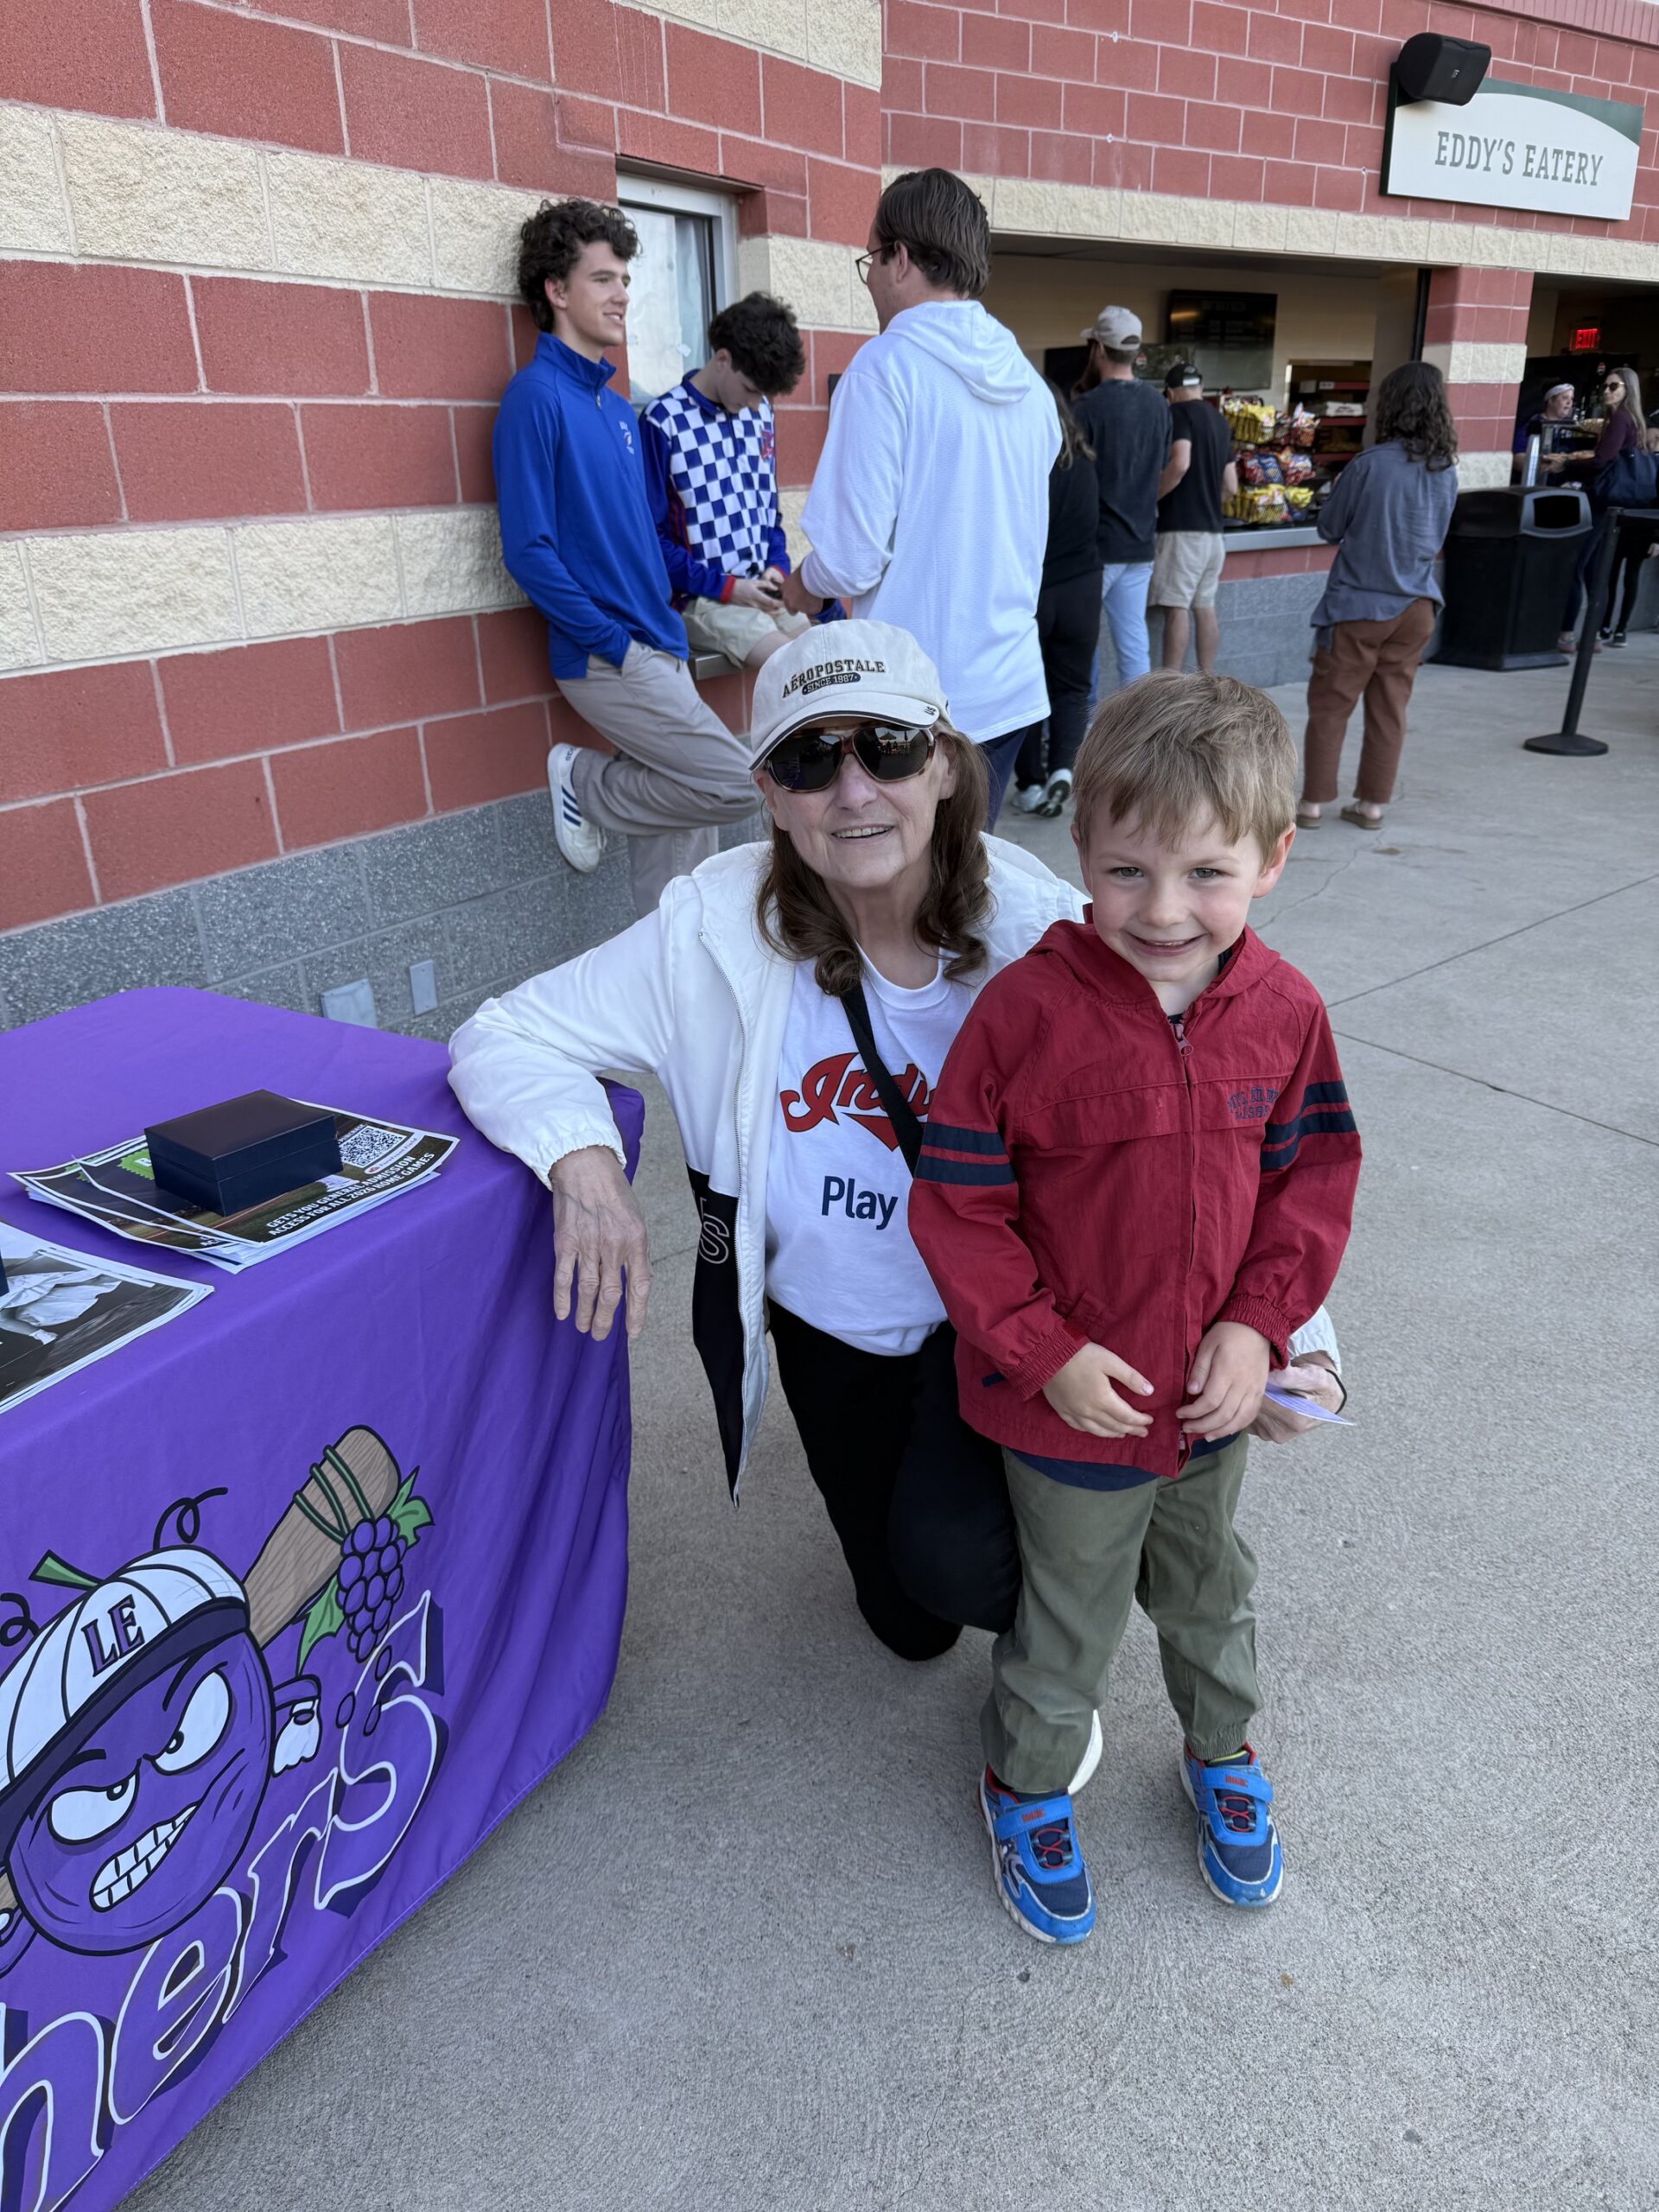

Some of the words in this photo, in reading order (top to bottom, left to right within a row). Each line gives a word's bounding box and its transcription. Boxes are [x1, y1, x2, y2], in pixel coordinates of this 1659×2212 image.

[1434, 130, 1516, 175] EDDY'S
[1522, 143, 1604, 187] EATERY
[1575, 328, 1598, 349] EXIT
[807, 678, 832, 692] SINCE
[834, 674, 854, 683] 1987
[780, 1052, 937, 1133] Indi
[266, 1212, 297, 1228] GETS
[293, 1203, 320, 1214] YOU
[316, 1184, 365, 1205] GENERAL
[361, 1155, 416, 1186] ADMISSION
[268, 1215, 310, 1236] ACCESS
[306, 1205, 332, 1217] FOR
[328, 1197, 352, 1208] ALL
[346, 1186, 377, 1199] 2026
[372, 1174, 405, 1189] HOME
[401, 1153, 435, 1176] GAMES
[822, 1175, 899, 1230] Play
[81, 1593, 145, 1678] LE
